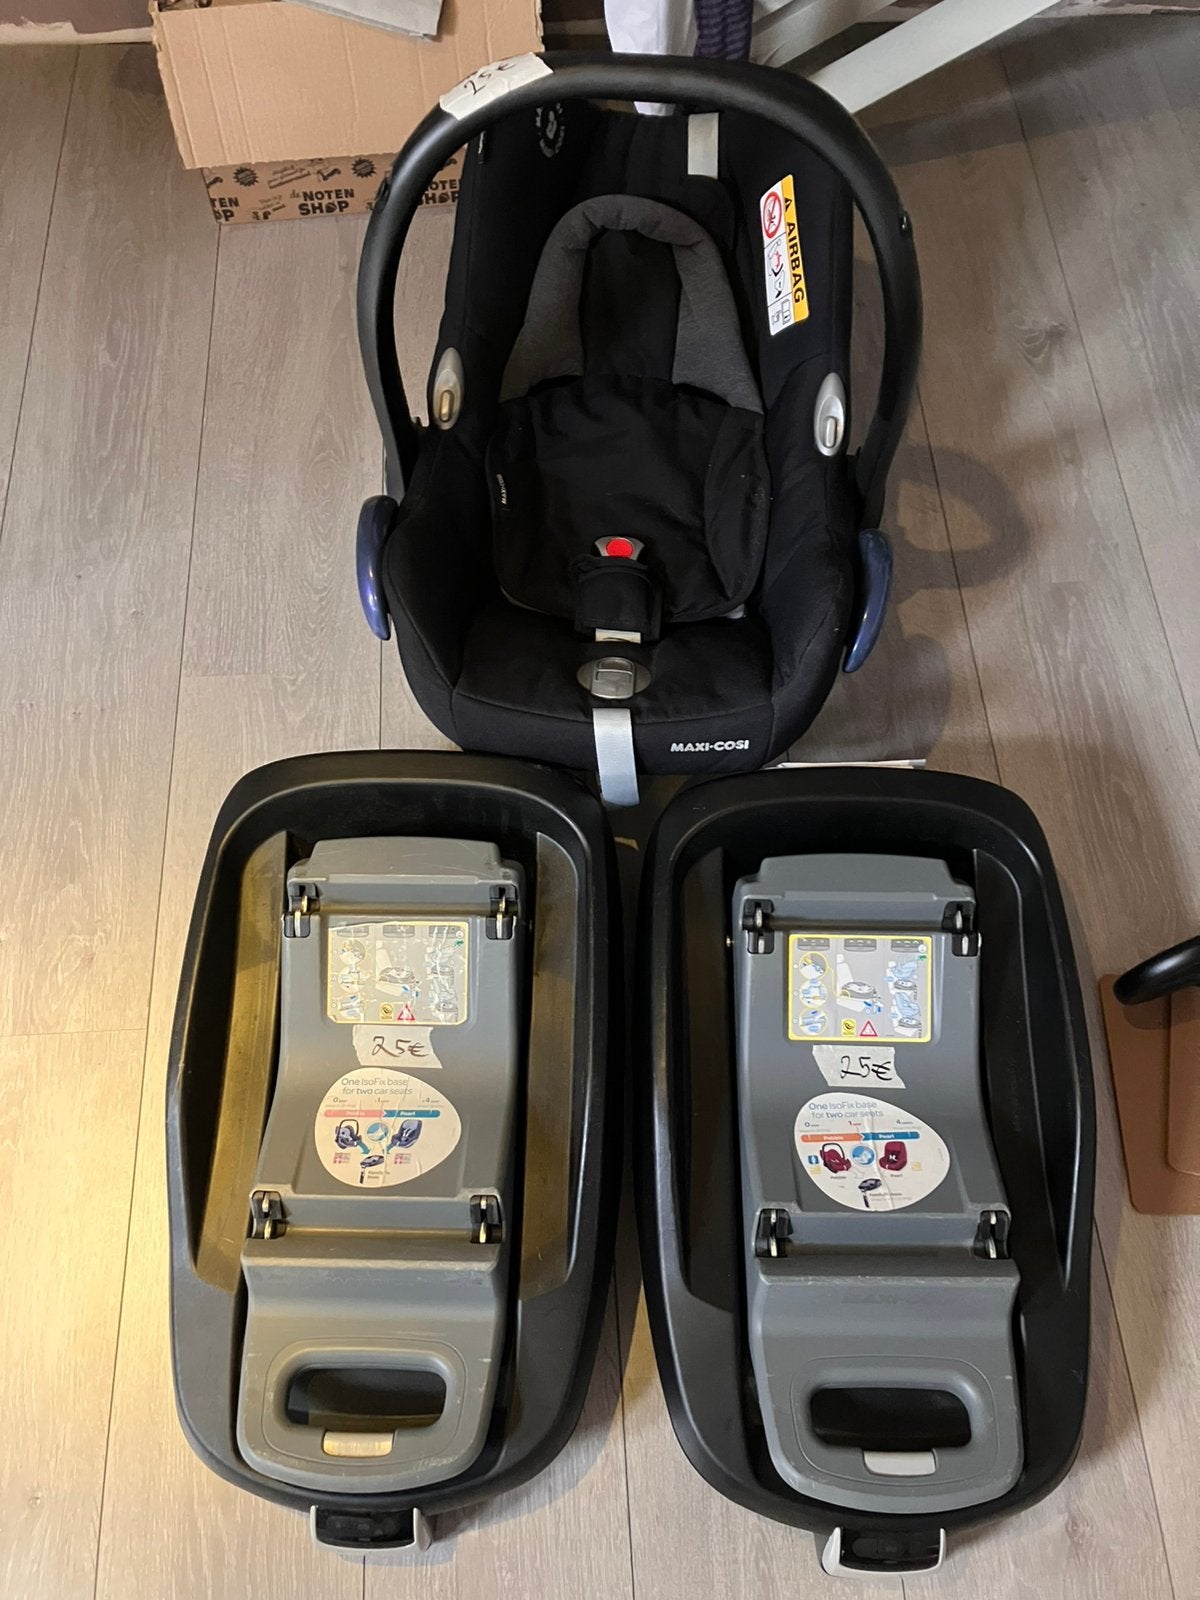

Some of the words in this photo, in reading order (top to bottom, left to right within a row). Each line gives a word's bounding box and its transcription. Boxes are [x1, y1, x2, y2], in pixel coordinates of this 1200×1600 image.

[302, 188, 355, 202] NOTEN
[298, 200, 350, 216] SHOP
[786, 222, 805, 303] AIRBAG
[670, 739, 750, 753] MAXI-COSI
[371, 1035, 430, 1058] 25€
[840, 1055, 893, 1081] 25€
[341, 1077, 360, 1086] One
[387, 1077, 409, 1086] base
[342, 1086, 355, 1095] for
[356, 1087, 373, 1095] two
[389, 1087, 413, 1095] seats
[808, 1102, 828, 1111] One
[829, 1101, 855, 1110] IsoFix
[855, 1100, 877, 1109] base
[812, 1111, 825, 1119] for
